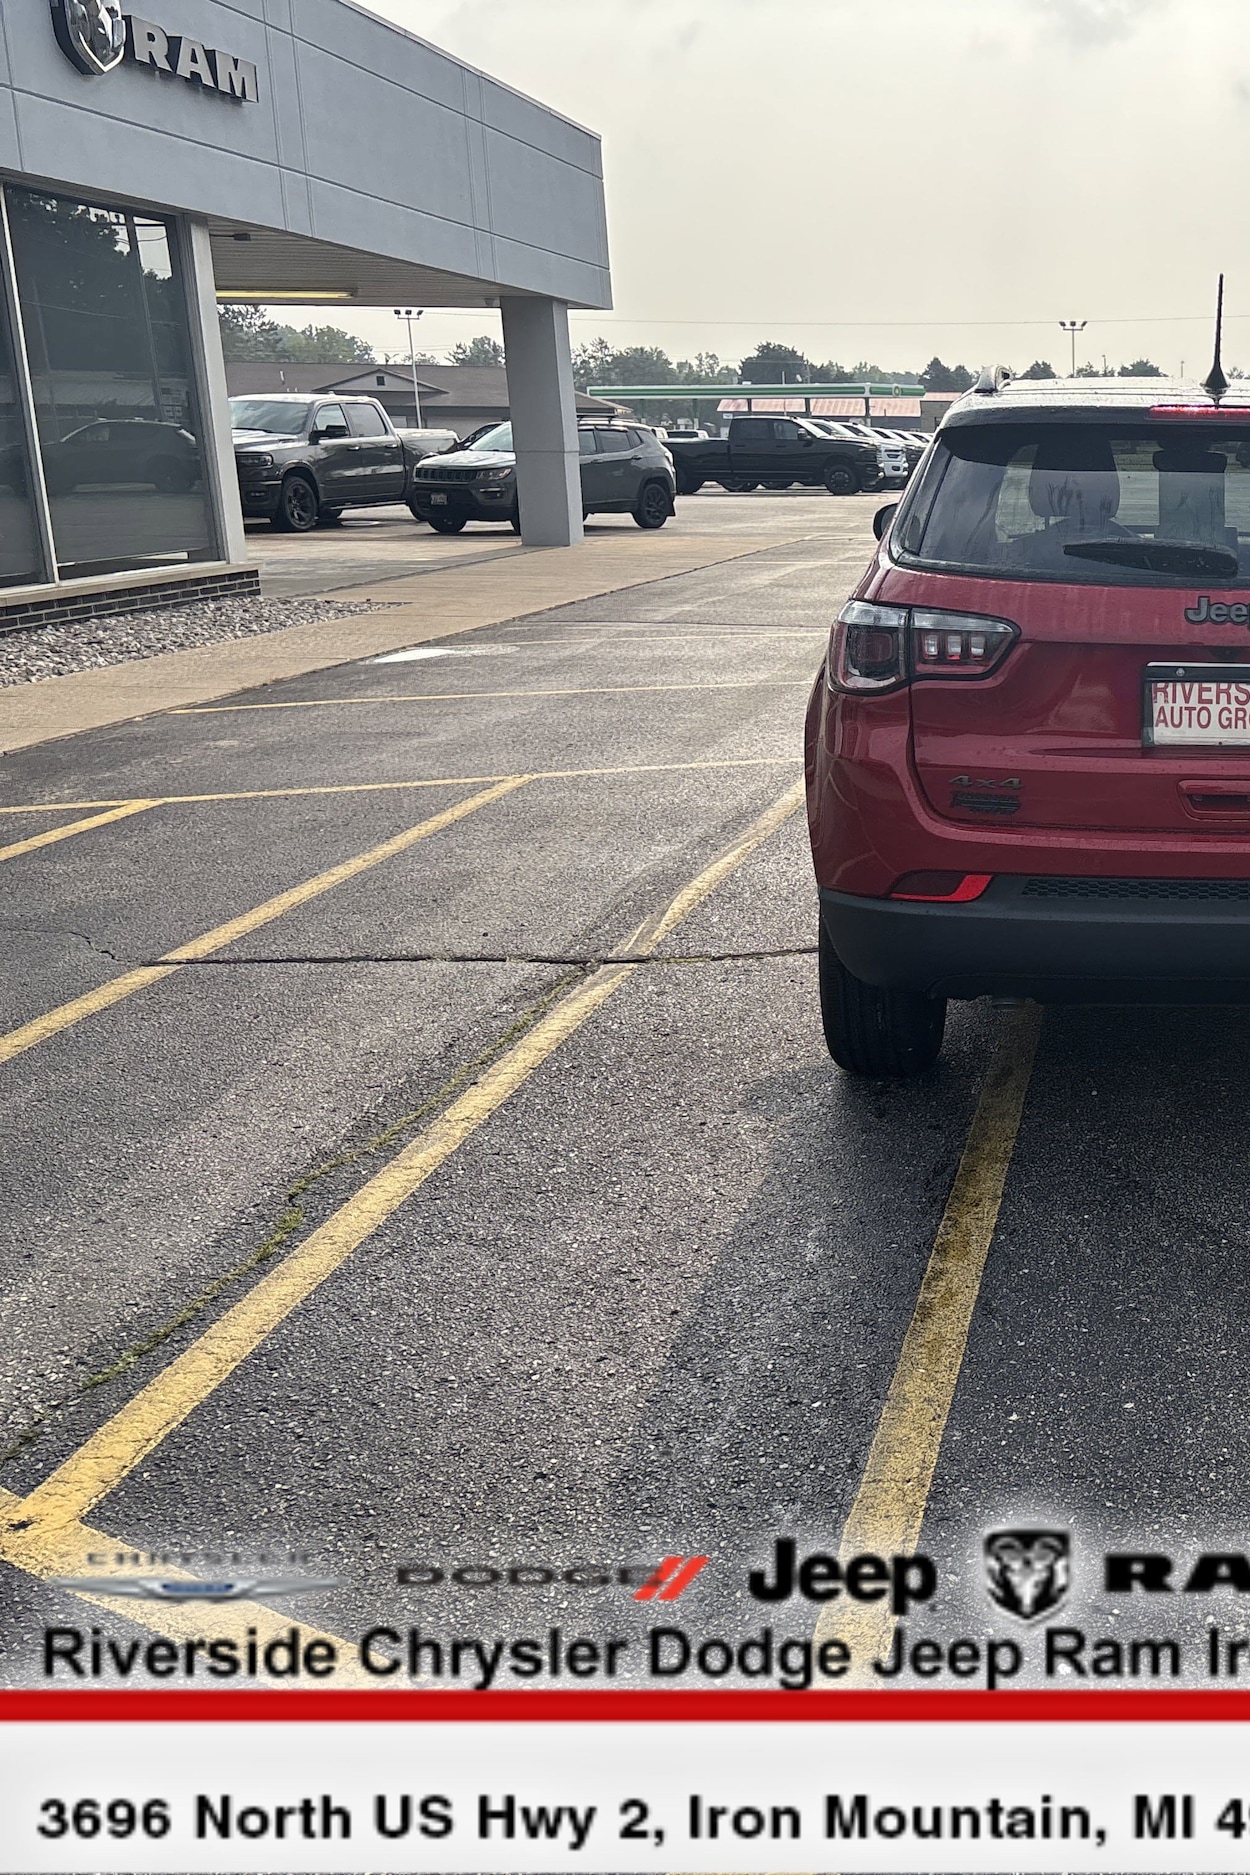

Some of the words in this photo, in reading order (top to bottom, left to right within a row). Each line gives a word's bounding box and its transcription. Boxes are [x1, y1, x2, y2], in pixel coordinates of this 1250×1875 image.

[130, 14, 258, 103] RAM
[1154, 706, 1212, 728] AUTO
[948, 775, 1023, 790] 4x4
